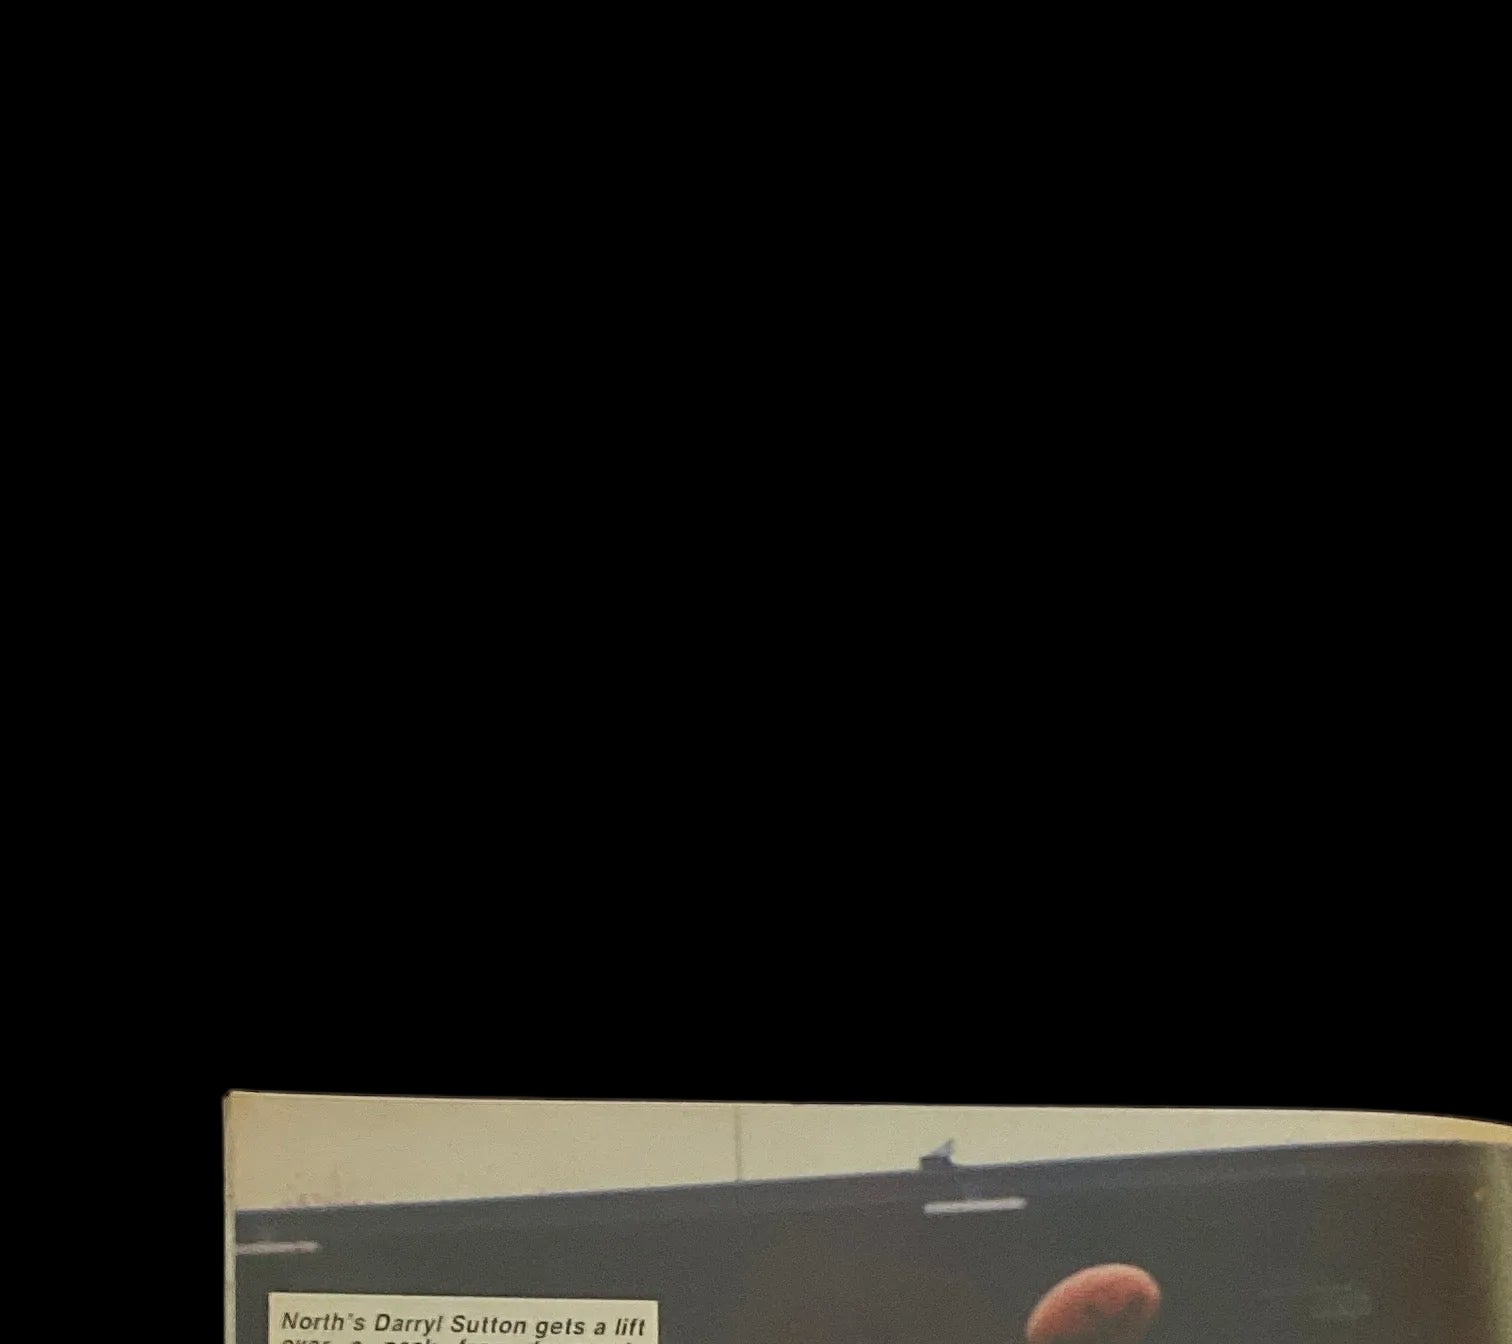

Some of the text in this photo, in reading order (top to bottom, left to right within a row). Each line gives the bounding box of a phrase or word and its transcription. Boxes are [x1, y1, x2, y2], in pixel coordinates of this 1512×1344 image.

[281, 1312, 645, 1338] North's Darryl Sutton gets a lift
